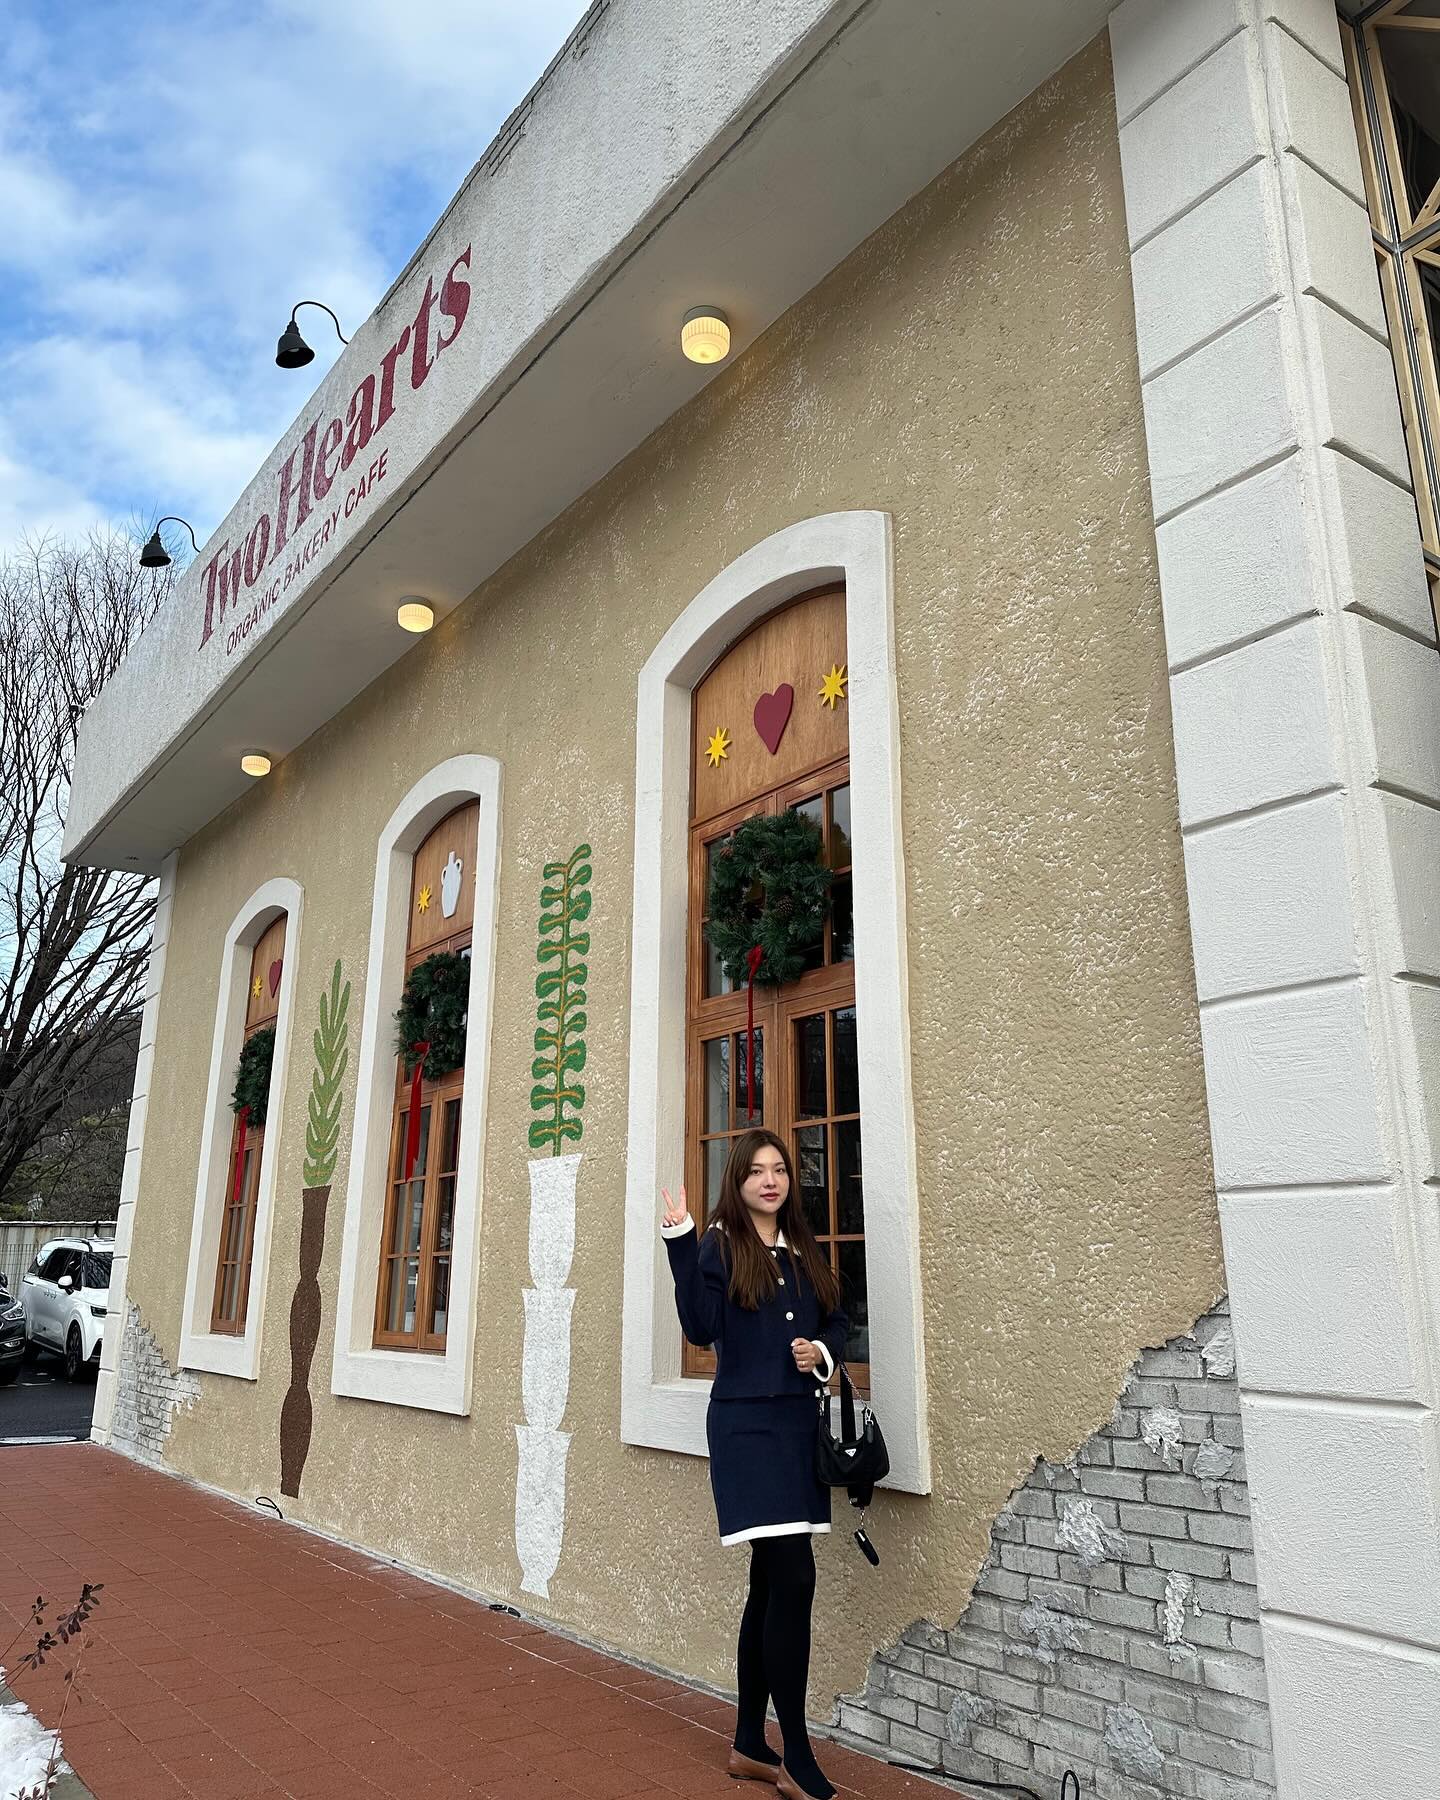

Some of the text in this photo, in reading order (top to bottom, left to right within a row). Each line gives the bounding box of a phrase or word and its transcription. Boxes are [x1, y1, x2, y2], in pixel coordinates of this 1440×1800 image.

[226, 448, 389, 656] ORGANIC BAKERY CAFE
